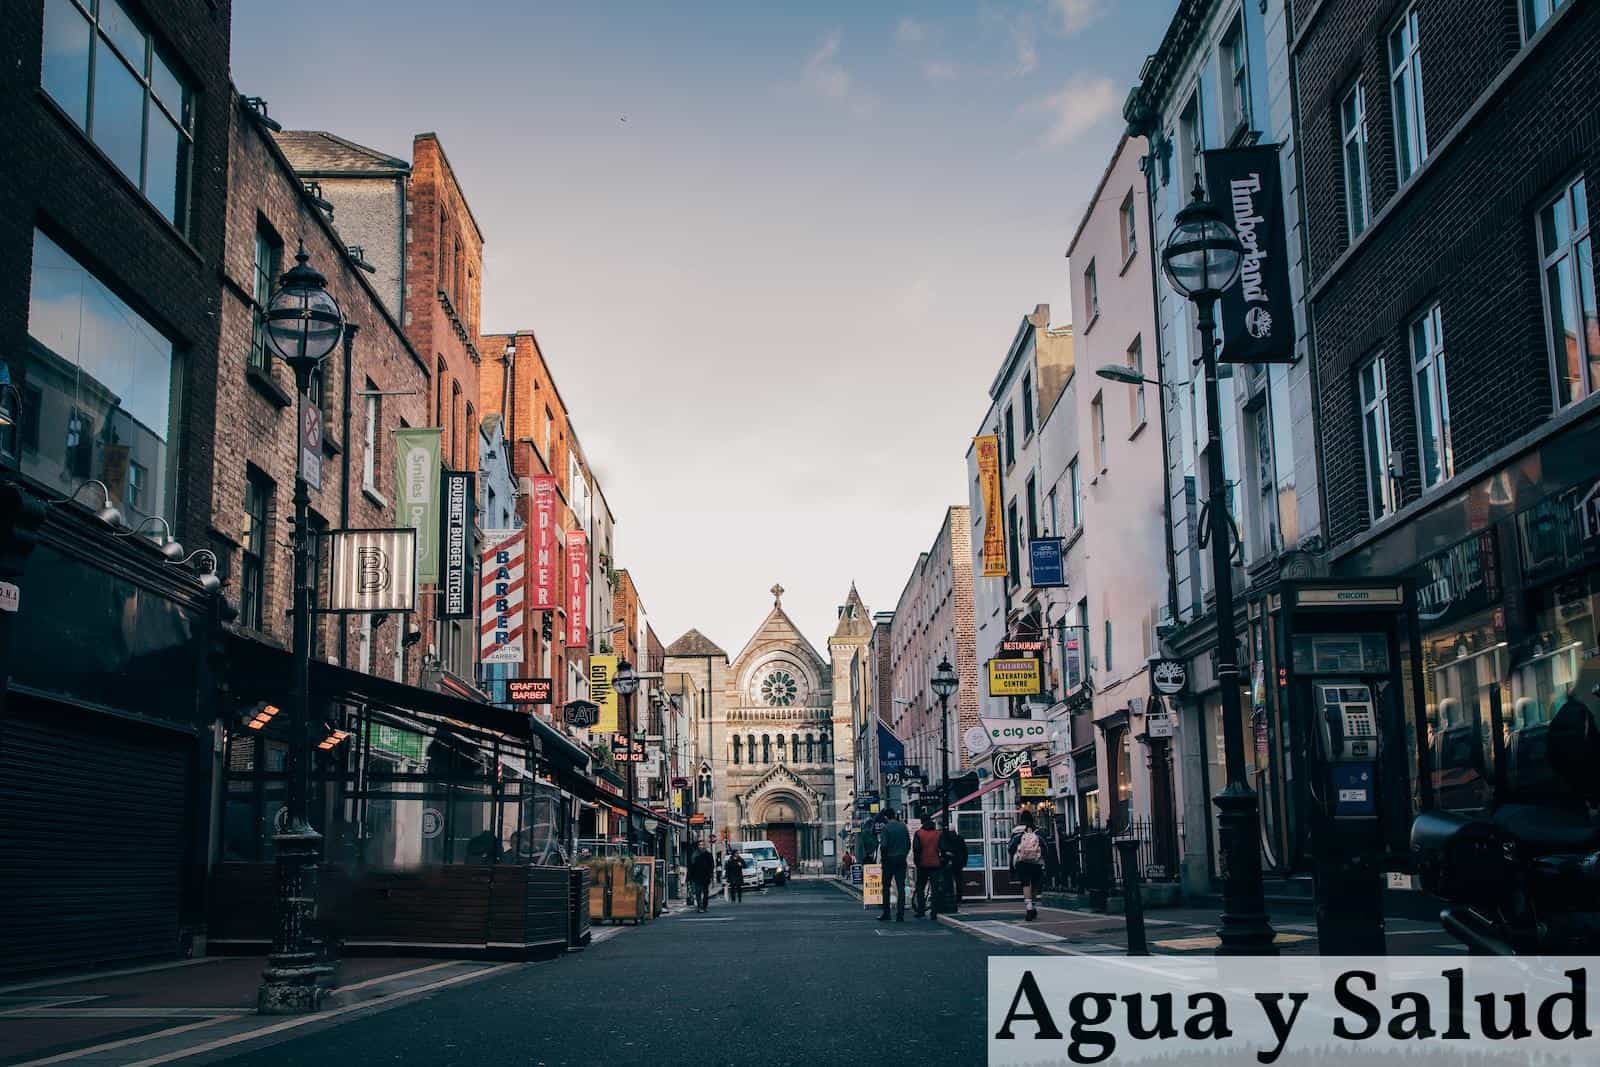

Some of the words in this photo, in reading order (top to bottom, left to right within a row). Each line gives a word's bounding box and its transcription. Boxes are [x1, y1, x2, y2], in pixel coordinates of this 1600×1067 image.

[1230, 173, 1269, 302] Timberland
[412, 455, 425, 498] Smiles
[451, 476, 464, 525] GOURMET
[450, 527, 463, 567] BURGER
[538, 511, 549, 605] DINER
[449, 569, 462, 615] KITCHEN
[495, 551, 511, 645] BARBER
[571, 563, 581, 643] DINER
[1337, 591, 1369, 600] eircom
[1004, 642, 1041, 650] RESTAURANT
[509, 682, 549, 691] GRAFTON
[512, 691, 547, 699] BARBER
[592, 665, 611, 704] GOTHAM
[995, 672, 1038, 680] ALTERATIONS
[1003, 680, 1028, 688] CENTRE
[565, 706, 596, 722] EAT
[992, 729, 1000, 737] e
[1003, 727, 1024, 739] cig
[1027, 726, 1044, 736] co
